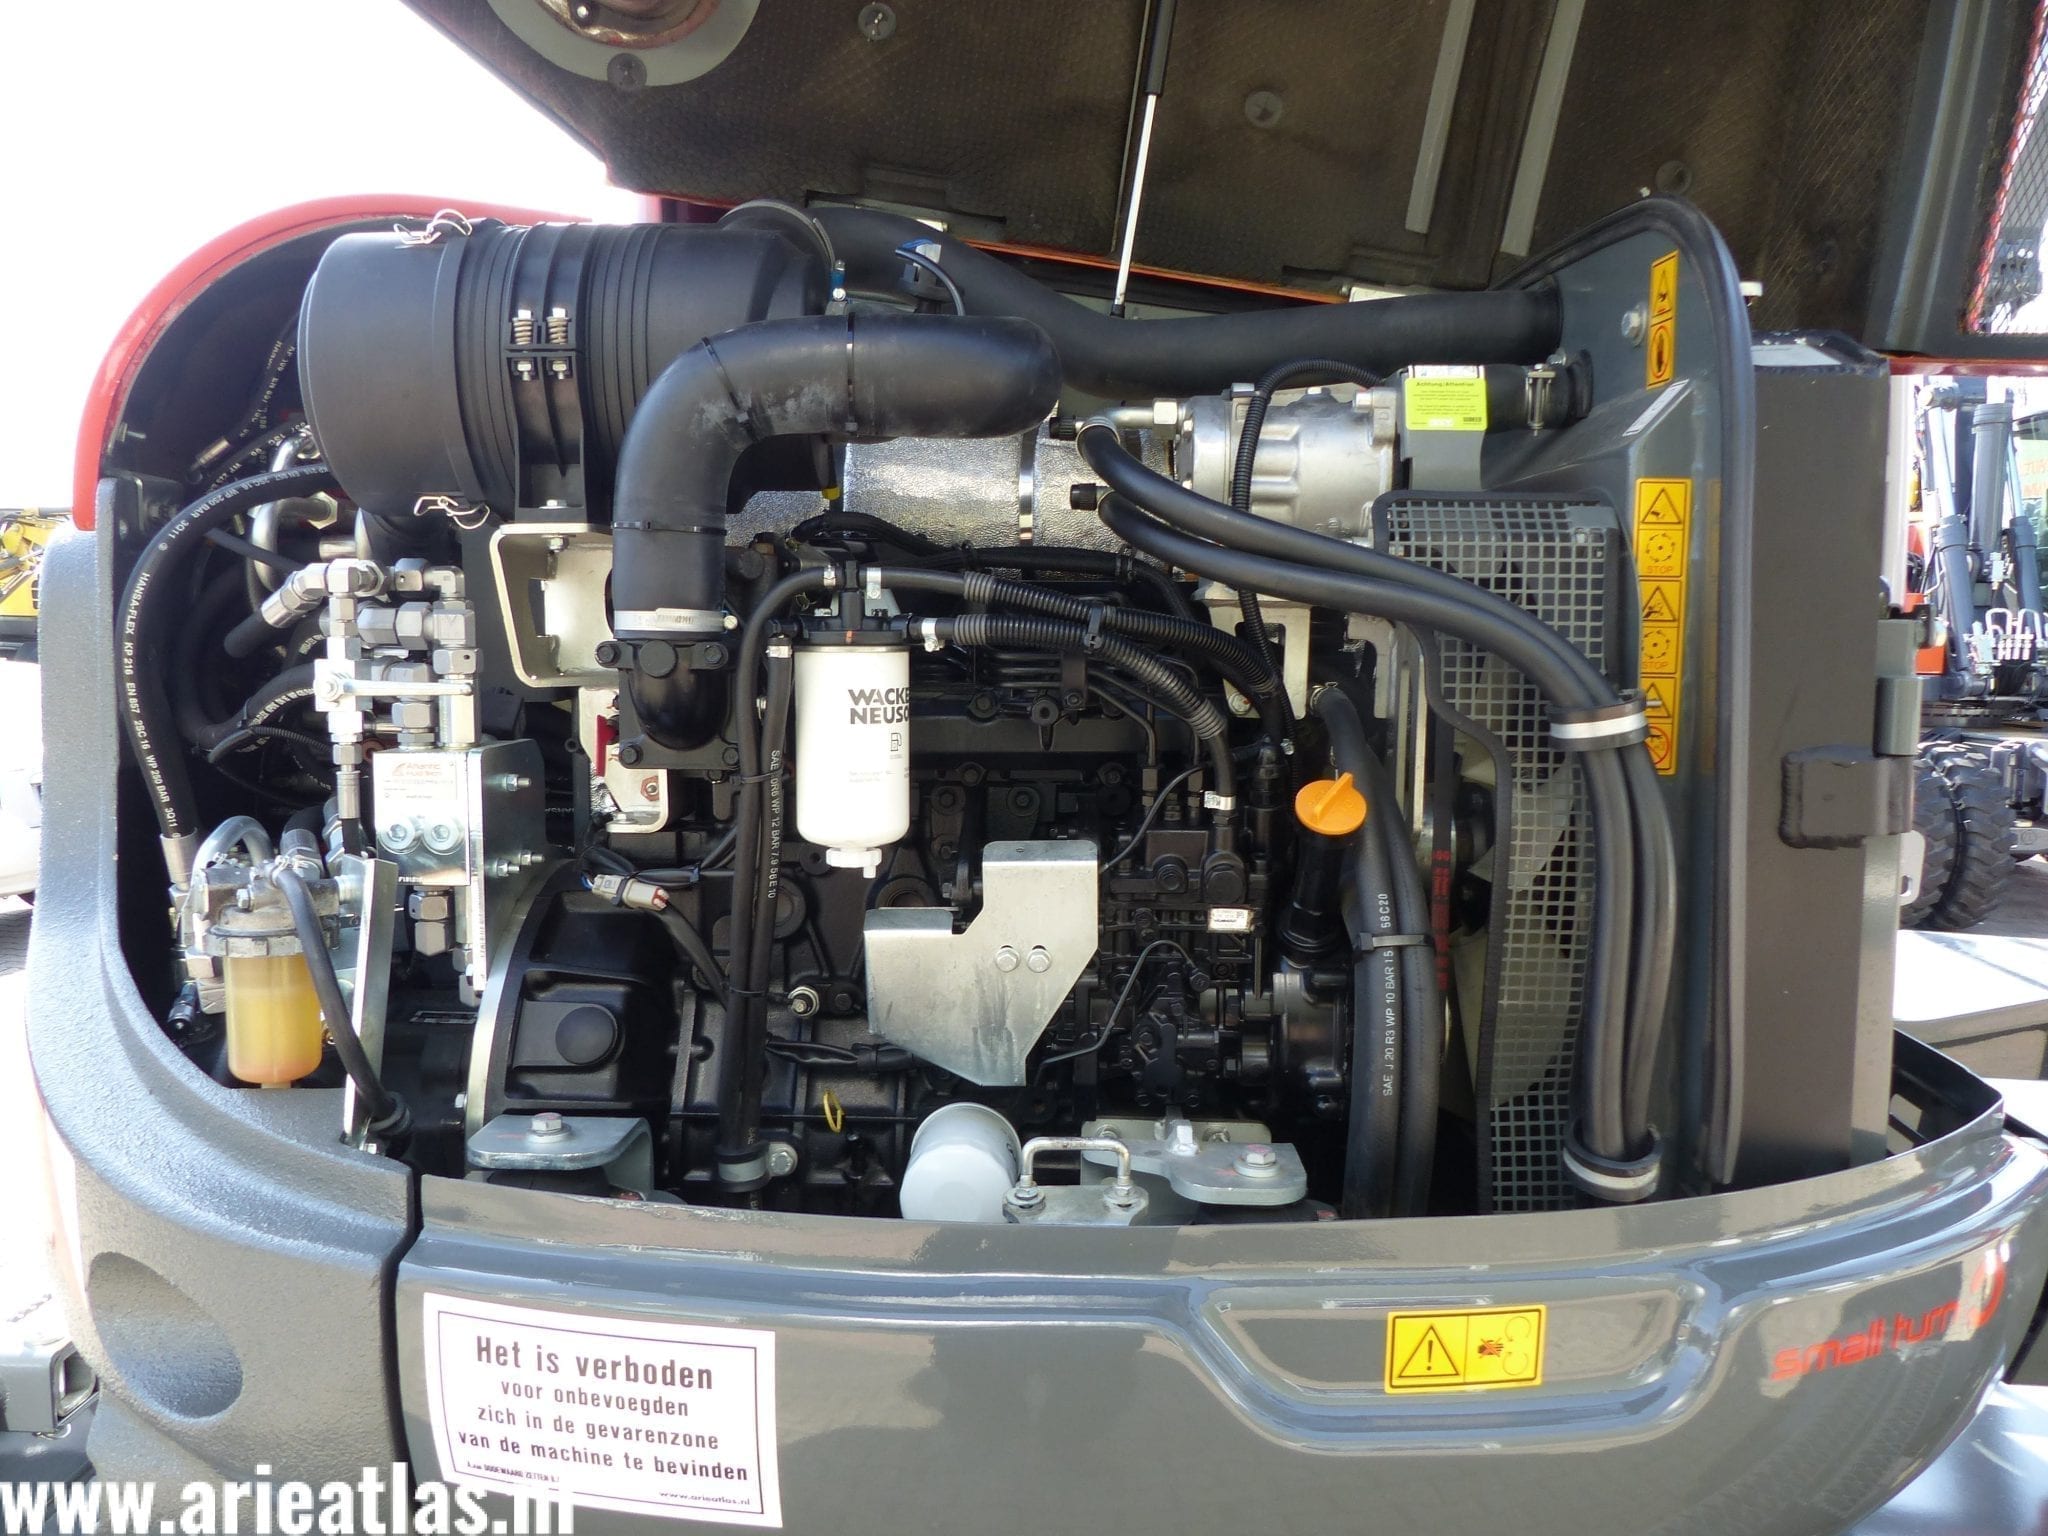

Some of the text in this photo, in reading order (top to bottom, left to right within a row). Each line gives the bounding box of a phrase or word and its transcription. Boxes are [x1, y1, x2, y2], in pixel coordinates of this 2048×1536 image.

[1646, 565, 1674, 574] STOP
[124, 572, 151, 635] HANSA-FLEX
[124, 642, 134, 657] KP
[126, 682, 137, 697] EN
[145, 754, 159, 770] WP
[770, 750, 781, 771] SAE
[156, 784, 171, 804] BAR
[772, 797, 780, 815] WP
[771, 818, 780, 828] 12
[771, 829, 781, 850] BAR
[1385, 967, 1396, 990] BAR
[1385, 992, 1396, 1004] 10
[1385, 1007, 1396, 1026] WP
[1385, 1029, 1396, 1044] R3
[1384, 1047, 1395, 1061] 20
[1383, 1074, 1394, 1097] SAE
[1770, 1316, 1887, 1382] small
[476, 1335, 714, 1390] Het is verboden
[500, 1380, 690, 1417] voor onbevoegden
[477, 1405, 719, 1450] zich in de gevarenzone
[458, 1430, 748, 1482] van de machine te bevinden
[658, 1491, 751, 1506] www.arieatlas.nl
